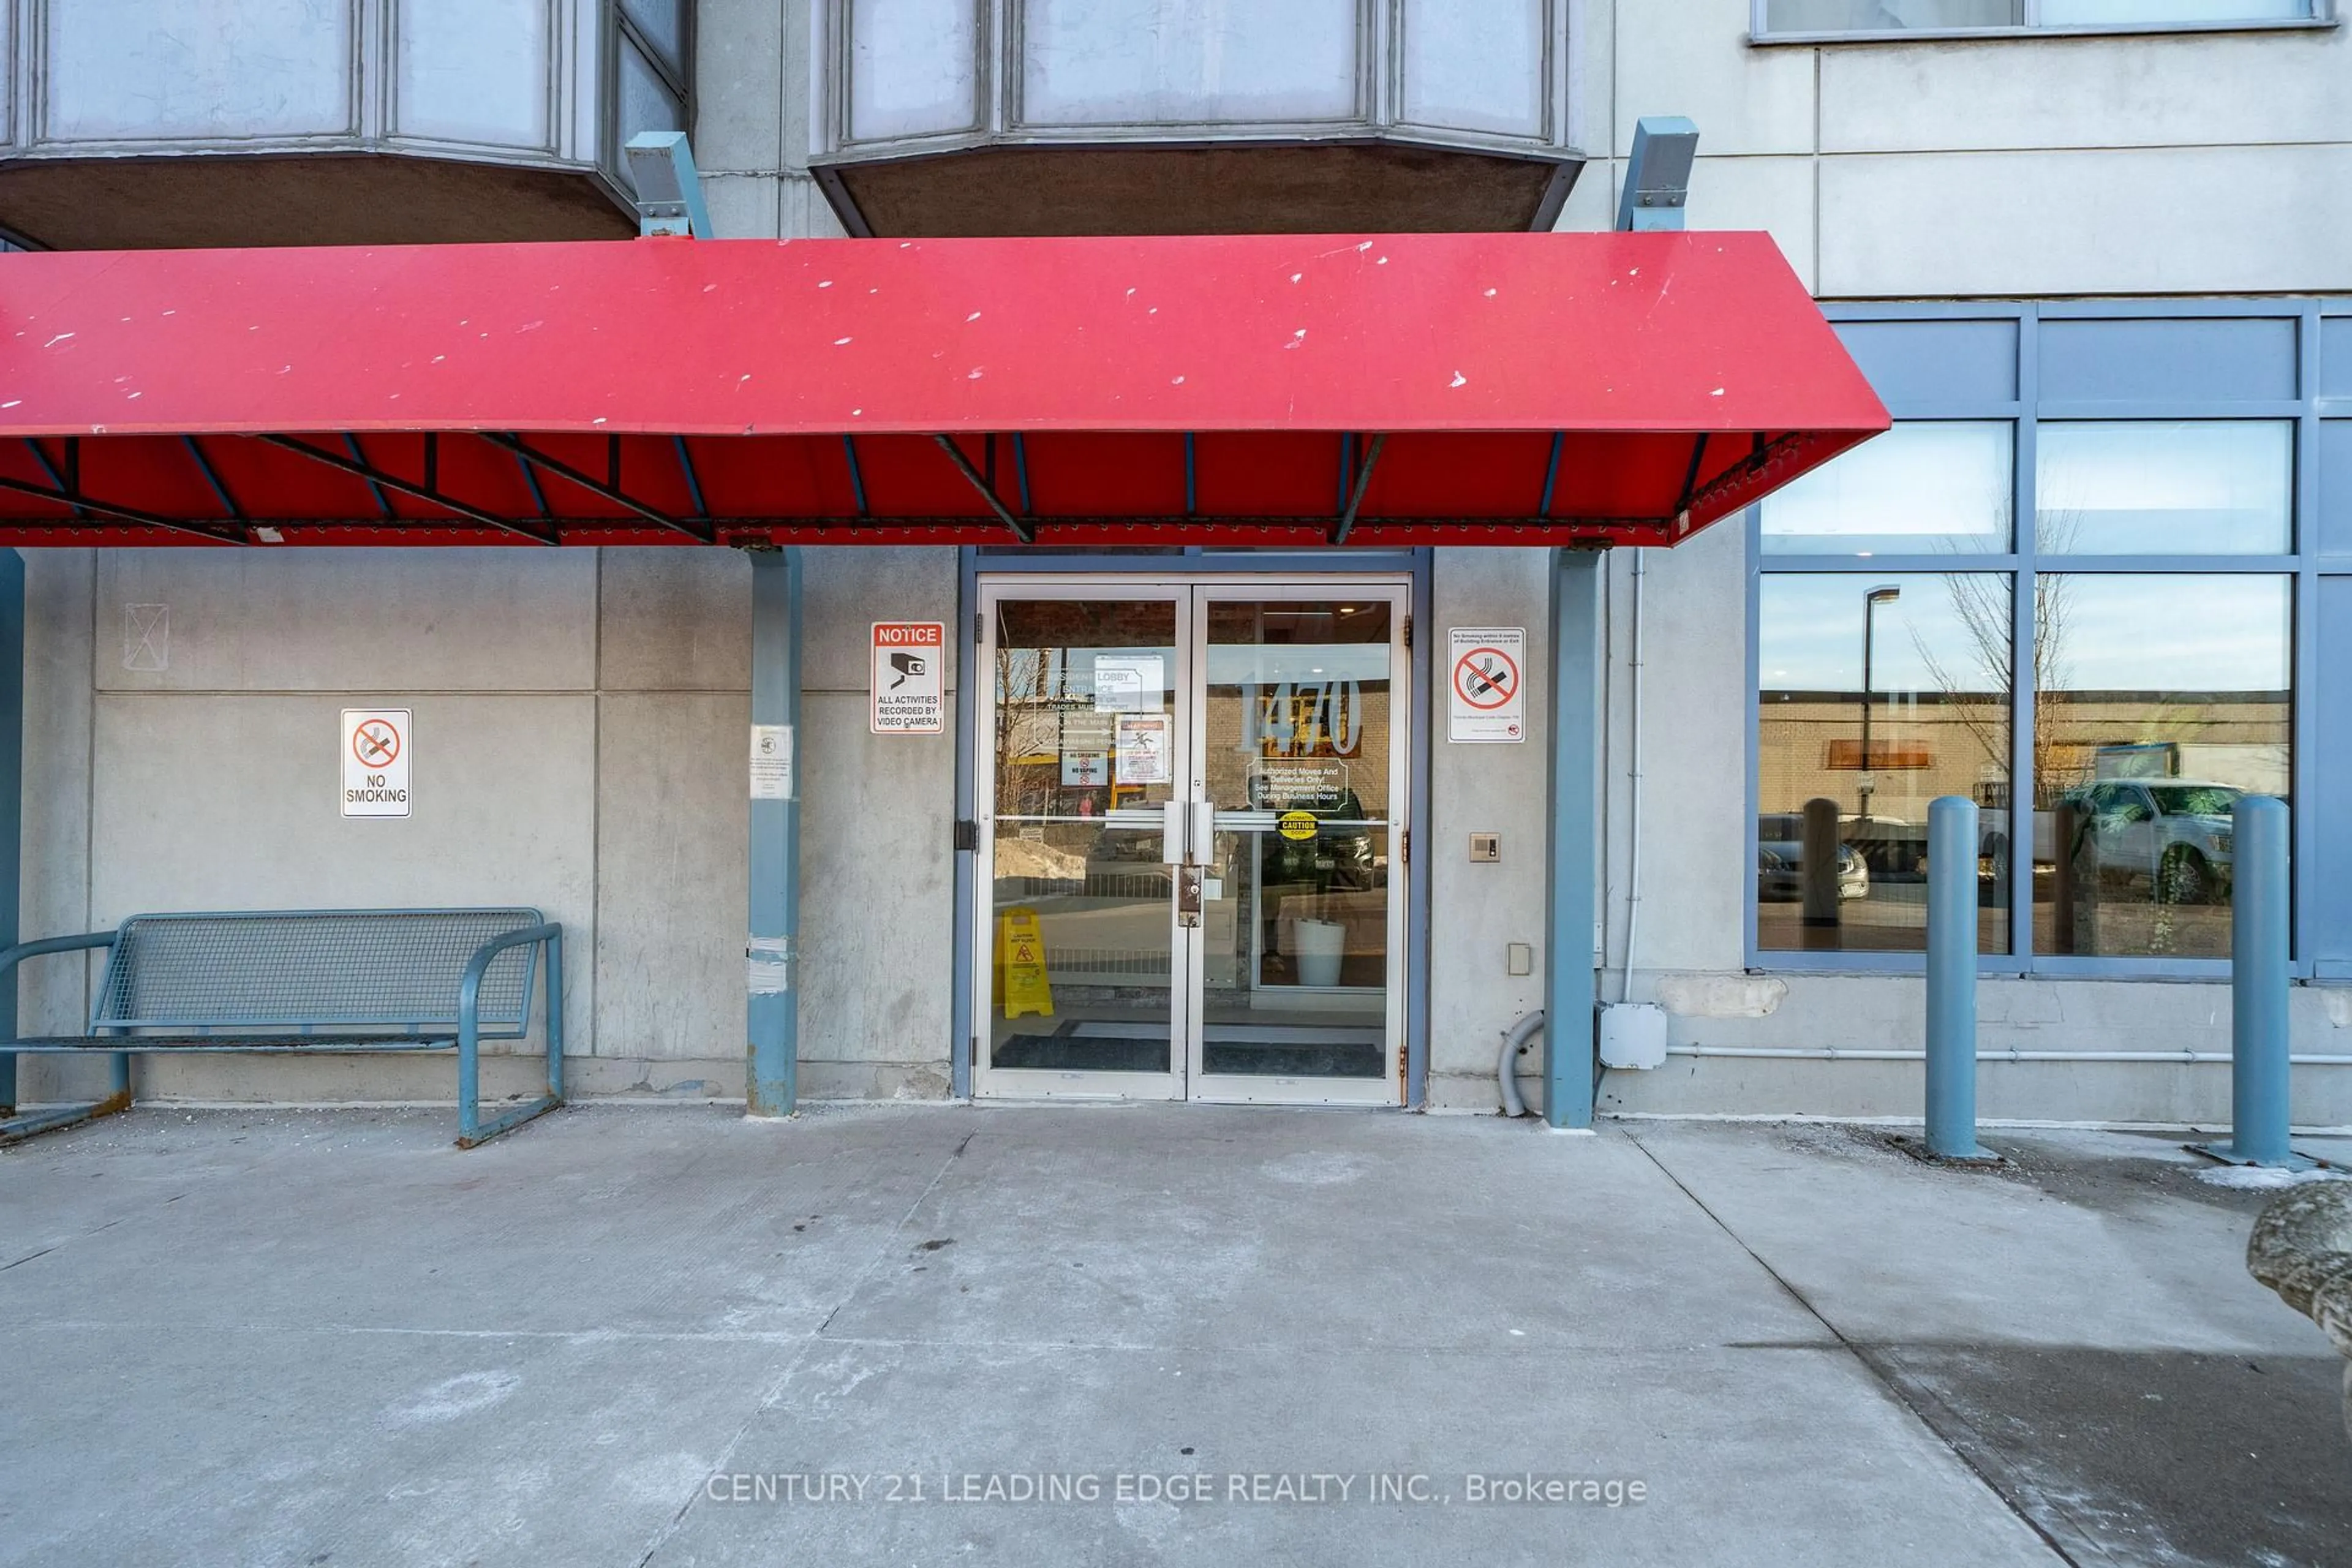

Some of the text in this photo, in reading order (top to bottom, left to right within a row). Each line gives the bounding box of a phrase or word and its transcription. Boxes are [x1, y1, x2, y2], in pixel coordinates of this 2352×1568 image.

[879, 628, 937, 643] NOTICE
[1098, 673, 1129, 681] LOBBY
[1063, 685, 1114, 693] ENTRANCE
[878, 696, 938, 704] ALL ACTIVITIES
[879, 706, 937, 715] RECORDED BY
[1235, 671, 1362, 755] 1470
[878, 717, 938, 726] VIDEO CAMERA
[367, 775, 386, 788] NO
[1270, 784, 1316, 793] Management
[347, 789, 407, 802] SMOKING
[1257, 793, 1281, 801] During
